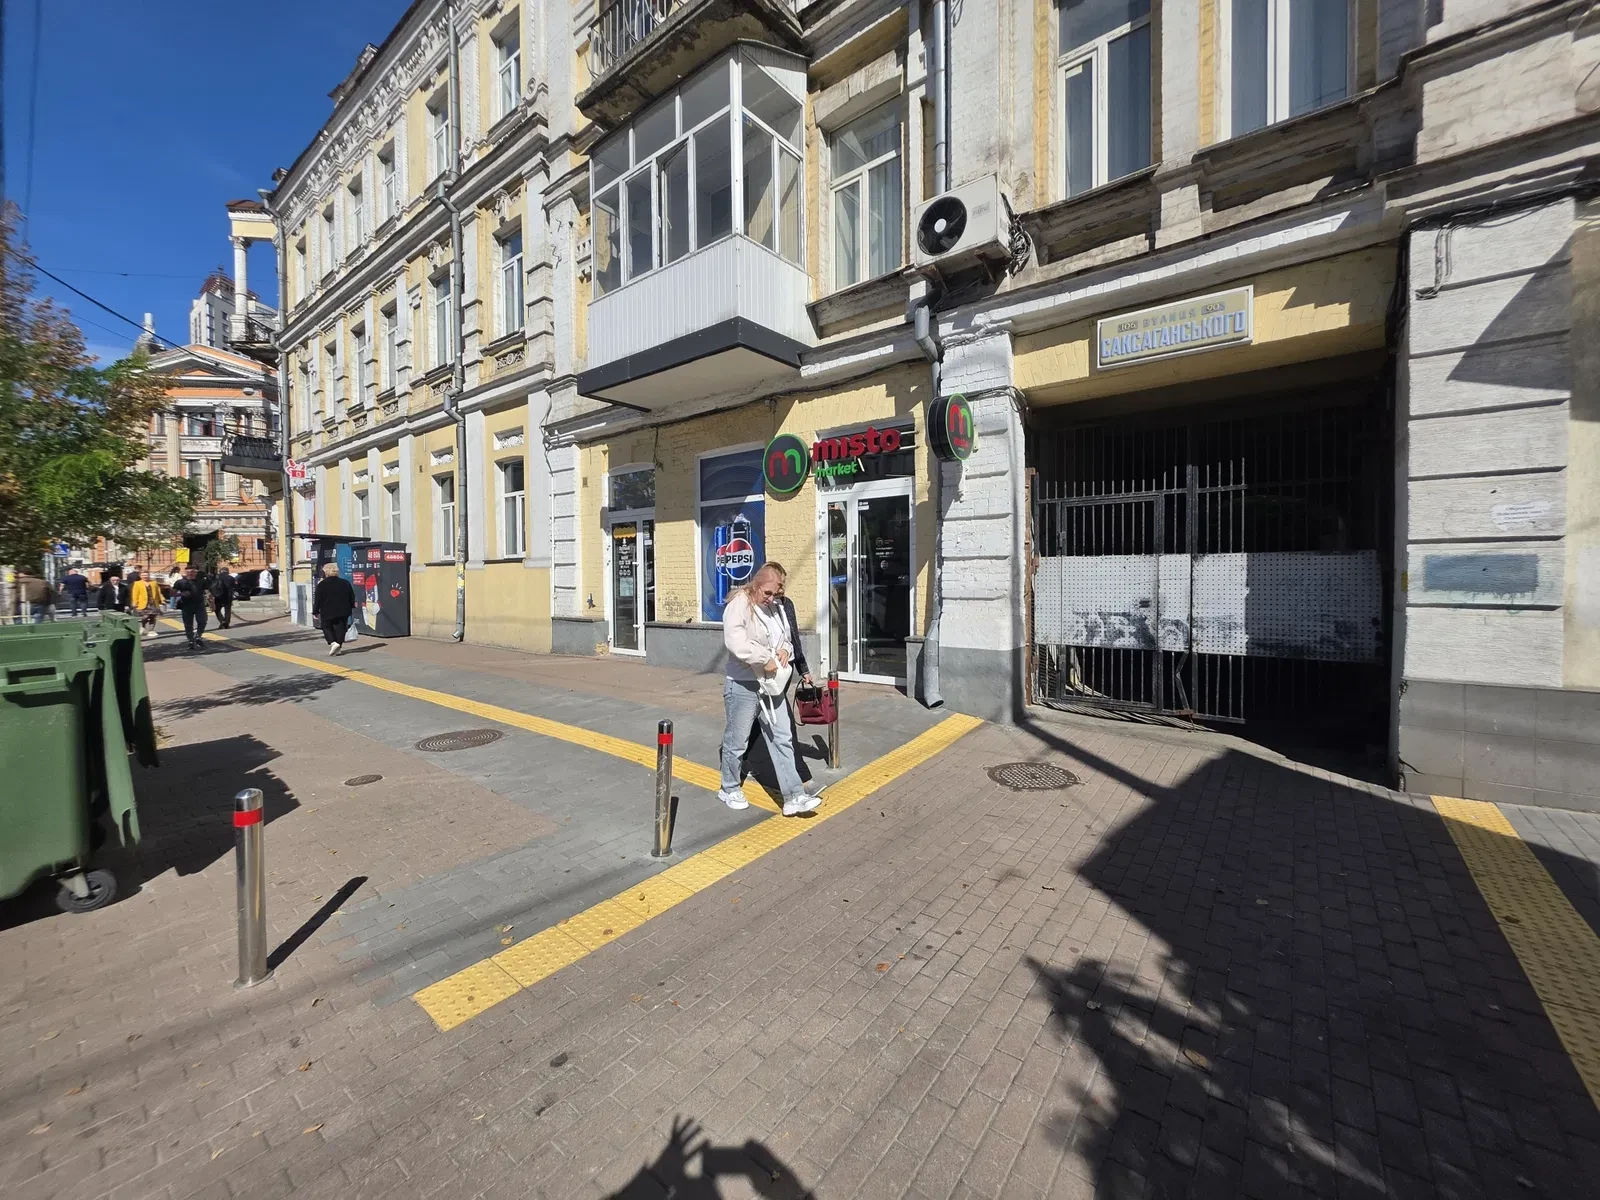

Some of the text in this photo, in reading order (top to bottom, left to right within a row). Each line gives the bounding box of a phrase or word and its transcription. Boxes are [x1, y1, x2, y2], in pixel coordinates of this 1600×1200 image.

[1120, 302, 1221, 332] 106 ВУЛИЦЯ 90
[1101, 310, 1246, 358] САКСАГАНСЬКОГО
[812, 426, 901, 462] misto
[815, 461, 858, 478] market
[726, 554, 752, 564] PEPSI
